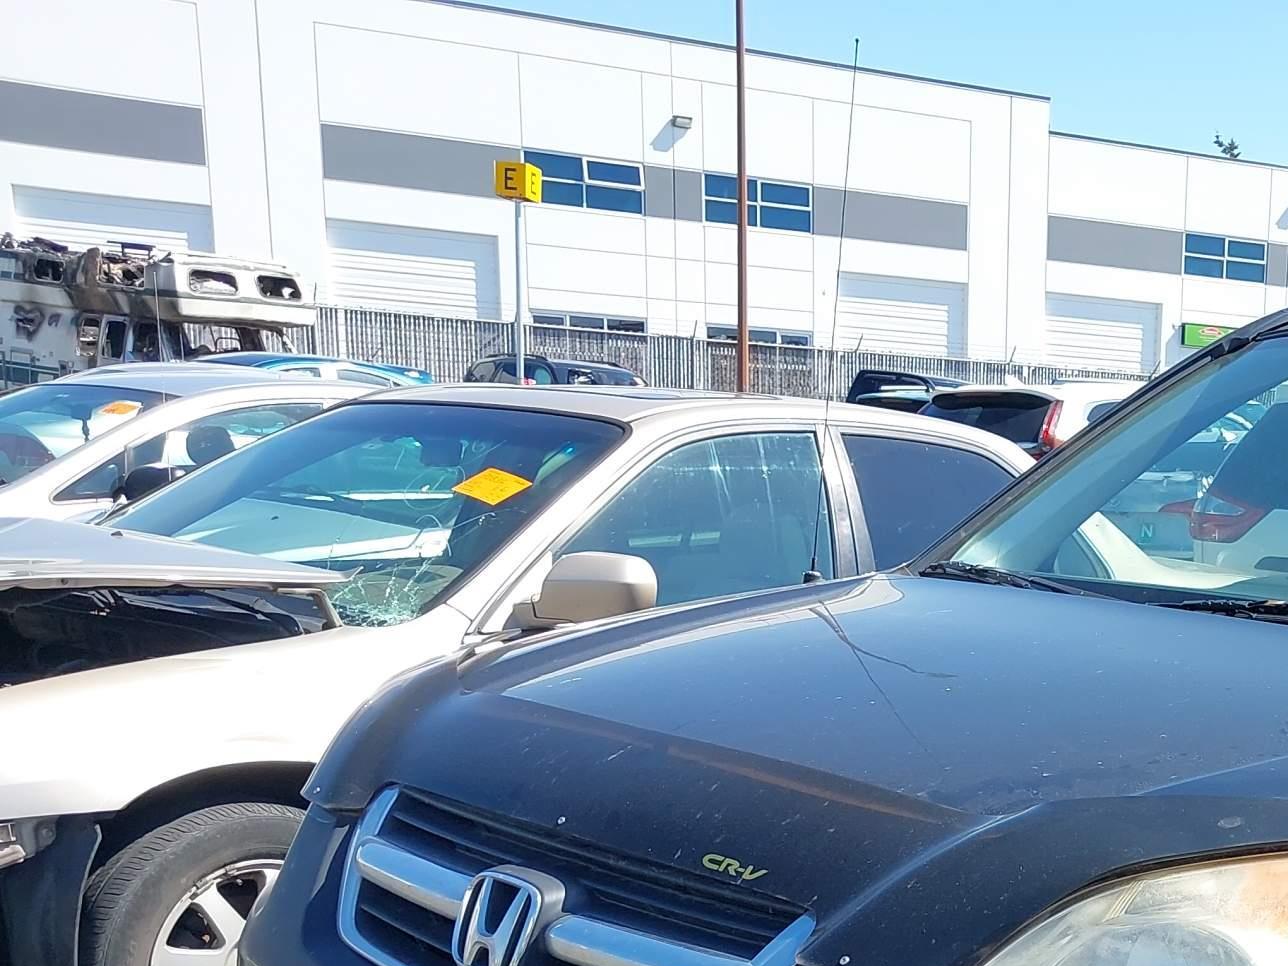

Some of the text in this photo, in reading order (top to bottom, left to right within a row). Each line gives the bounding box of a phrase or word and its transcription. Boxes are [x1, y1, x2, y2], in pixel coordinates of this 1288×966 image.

[504, 167, 517, 190] E
[530, 171, 537, 195] E
[702, 853, 769, 881] CR-V
